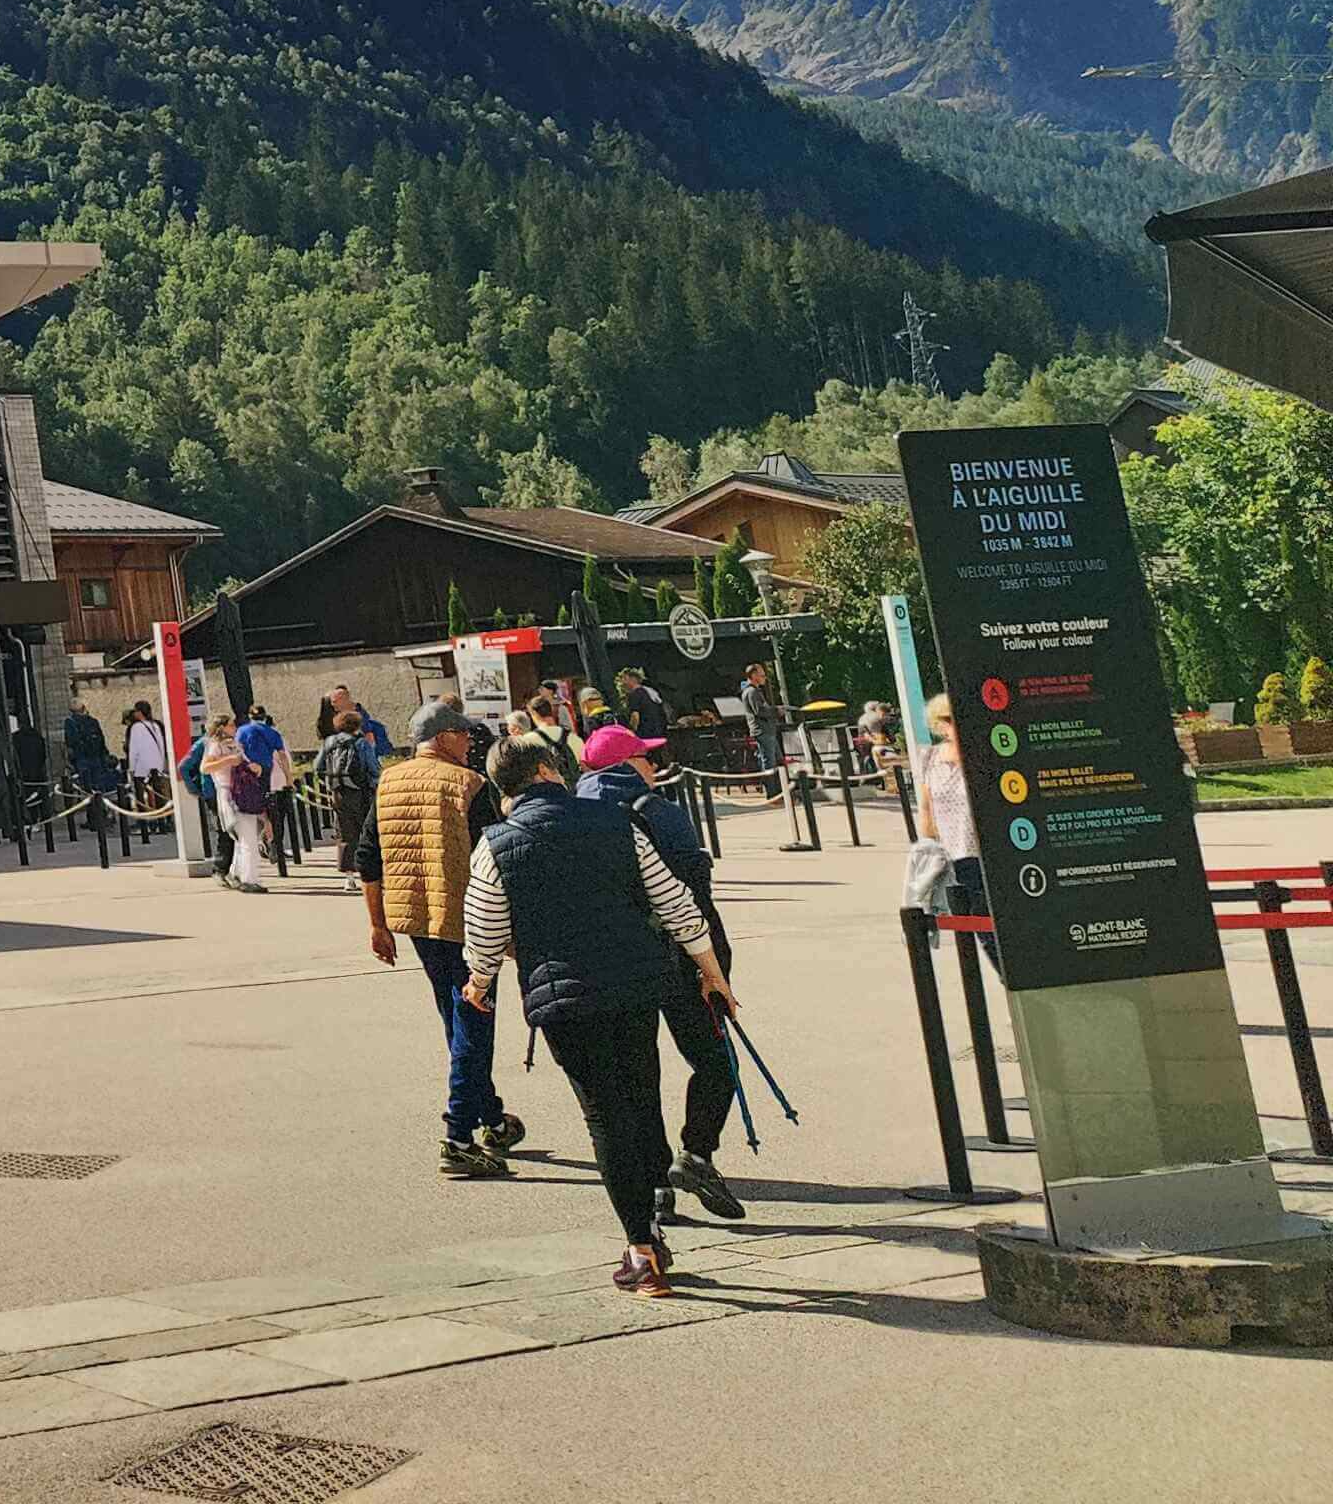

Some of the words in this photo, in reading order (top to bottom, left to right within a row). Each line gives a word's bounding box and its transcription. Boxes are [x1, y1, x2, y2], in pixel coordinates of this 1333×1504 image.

[949, 457, 1074, 482] BIENVENUE
[952, 485, 968, 508] À
[973, 483, 1085, 508] L'AIGUILLE
[980, 512, 1012, 533] DU
[1018, 510, 1066, 532] MIDI
[982, 538, 1010, 552] 1035
[1010, 537, 1022, 551] M
[1033, 536, 1060, 549] 3842
[1061, 534, 1073, 548] M
[957, 563, 1007, 578] WELCOME
[980, 622, 1024, 637] Suivez
[1026, 620, 1059, 634] votre
[1062, 616, 1109, 631] couleur
[1002, 637, 1036, 651] Follow
[1037, 636, 1060, 651] your
[1062, 634, 1093, 647] colour
